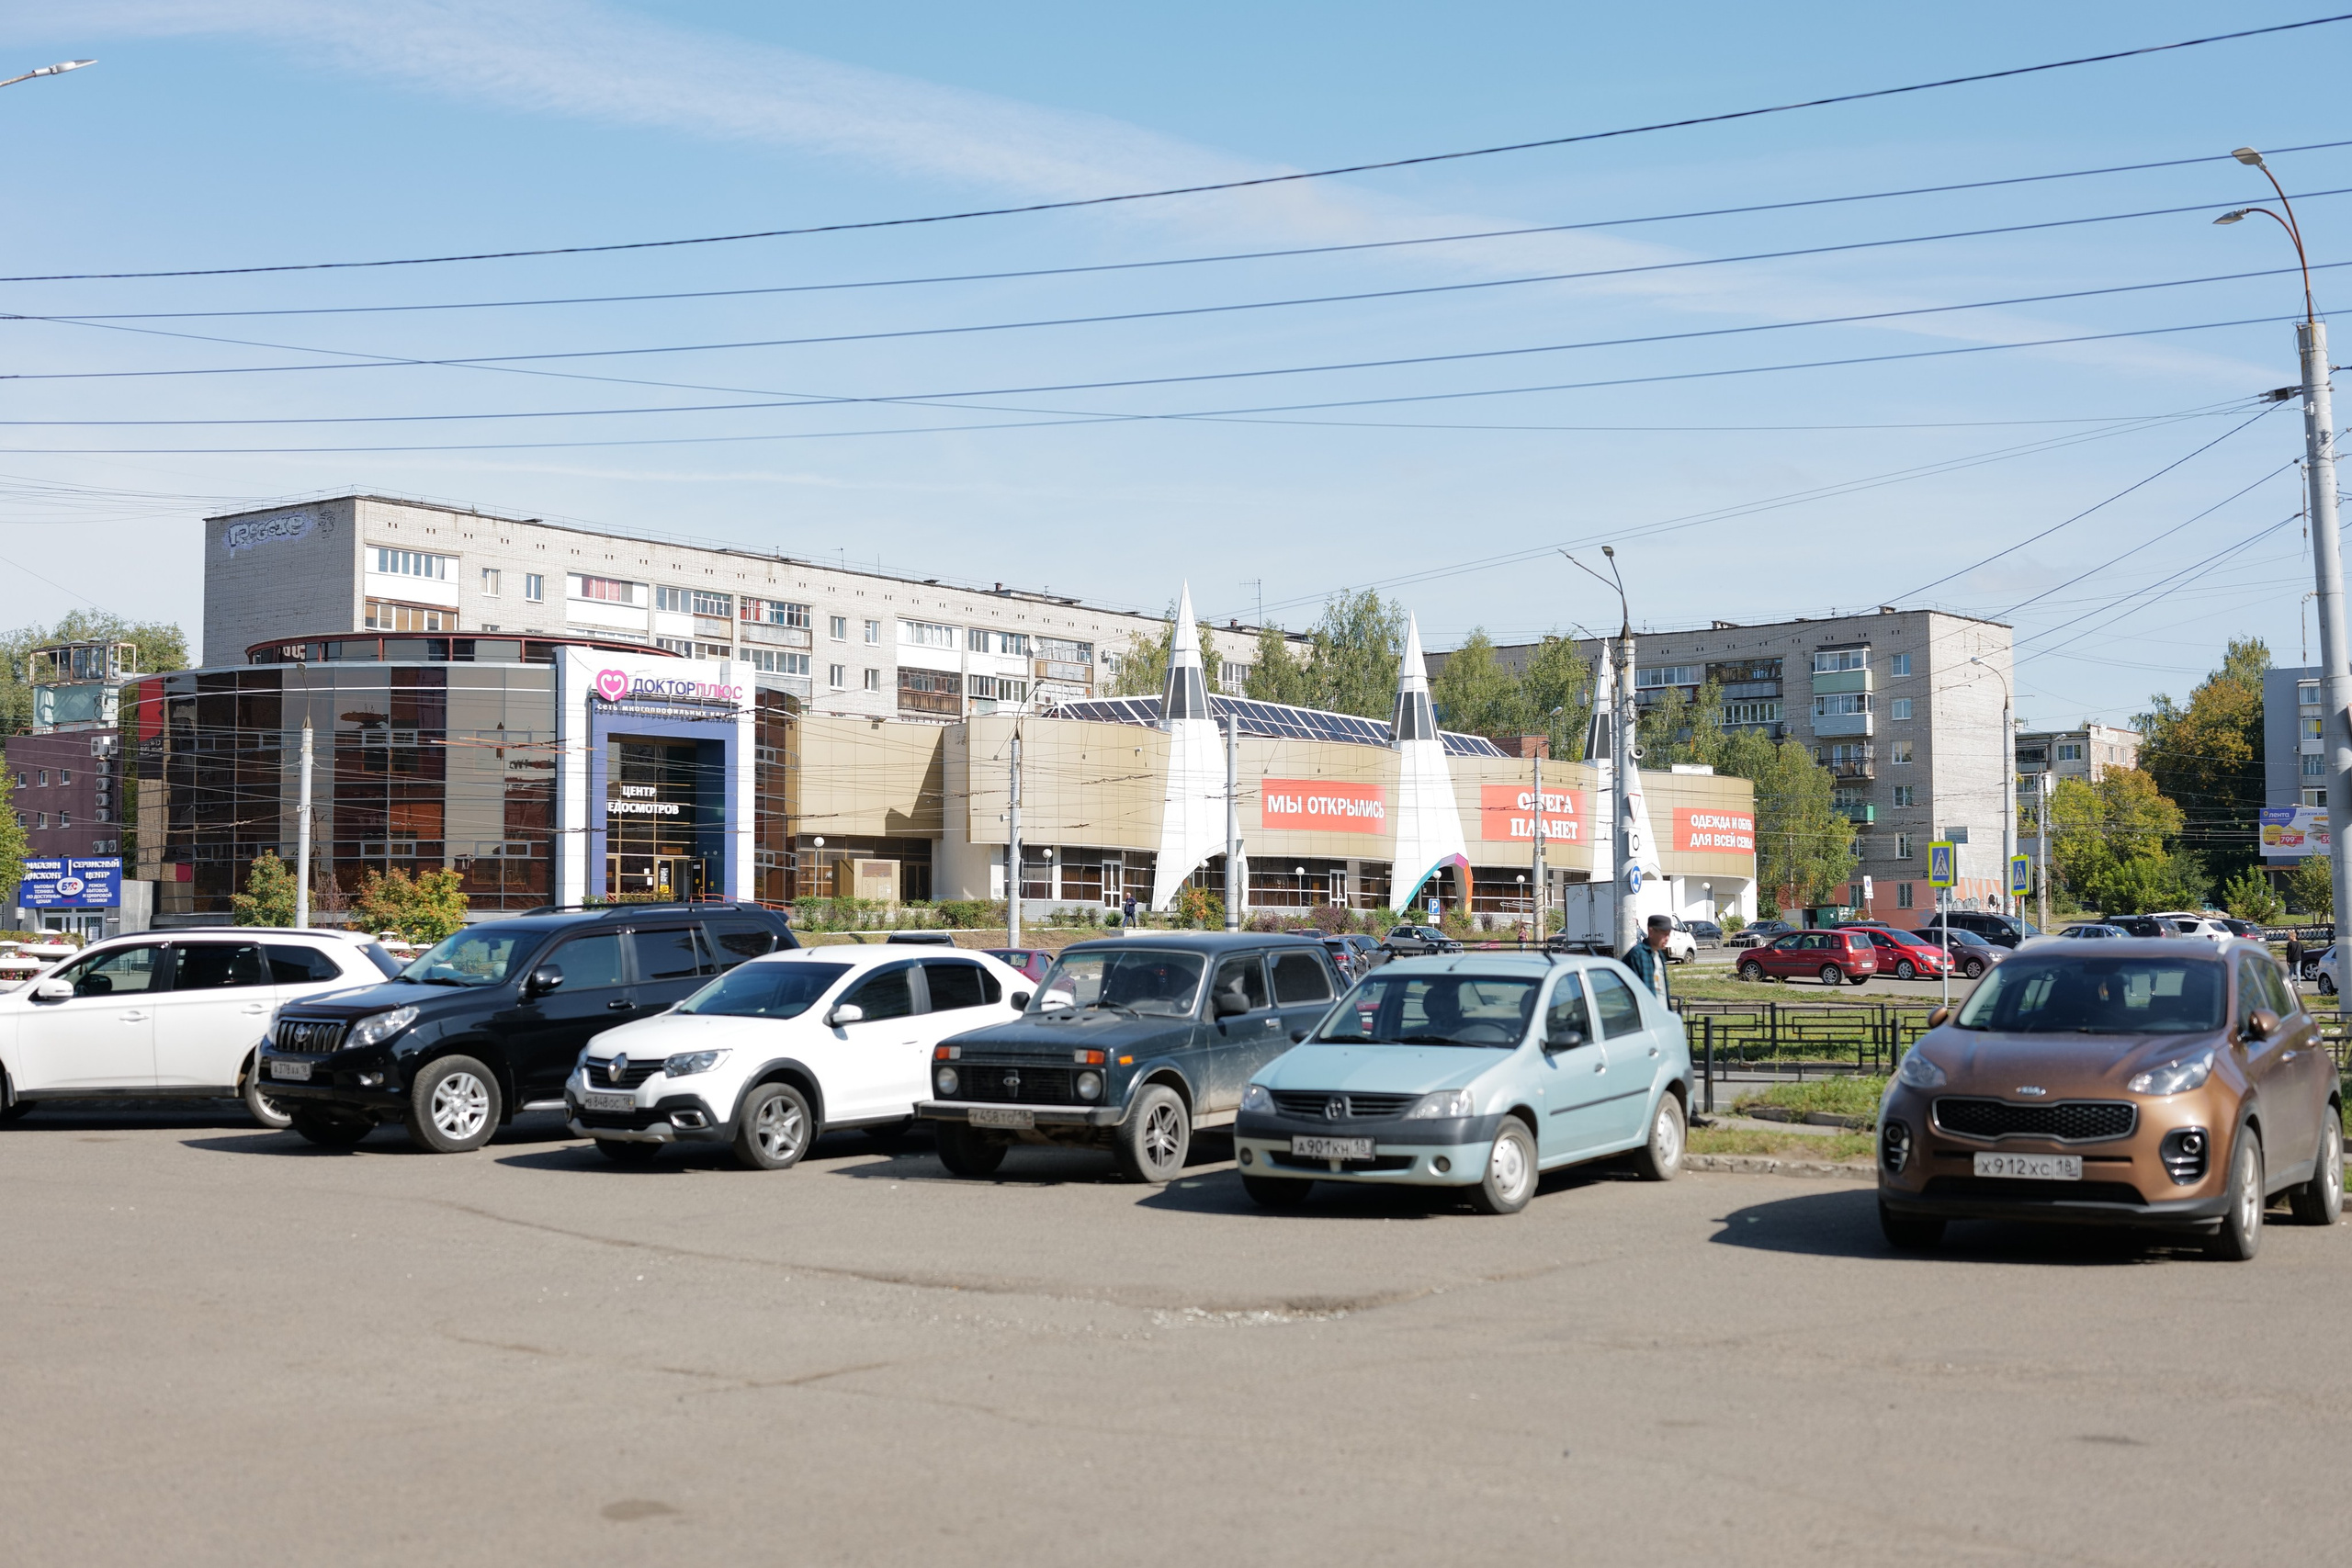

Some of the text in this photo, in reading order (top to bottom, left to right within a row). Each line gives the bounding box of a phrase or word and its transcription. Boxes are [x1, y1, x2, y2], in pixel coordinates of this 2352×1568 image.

[632, 678, 743, 699] ДОКТОРПЛЮС
[622, 785, 657, 797] ЦЕНТР
[606, 801, 679, 815] ЕДОСМОТРОВ
[1268, 795, 1385, 818] МЫ ОТКРЫЛИСЬ
[1690, 815, 1731, 830] ОДЕЖДА
[1731, 818, 1737, 829] И
[1690, 833, 1712, 848] ДЛЯ
[1713, 832, 1736, 848] ВСЕЙ
[73, 859, 120, 868] СЕРВИСНЫЙ
